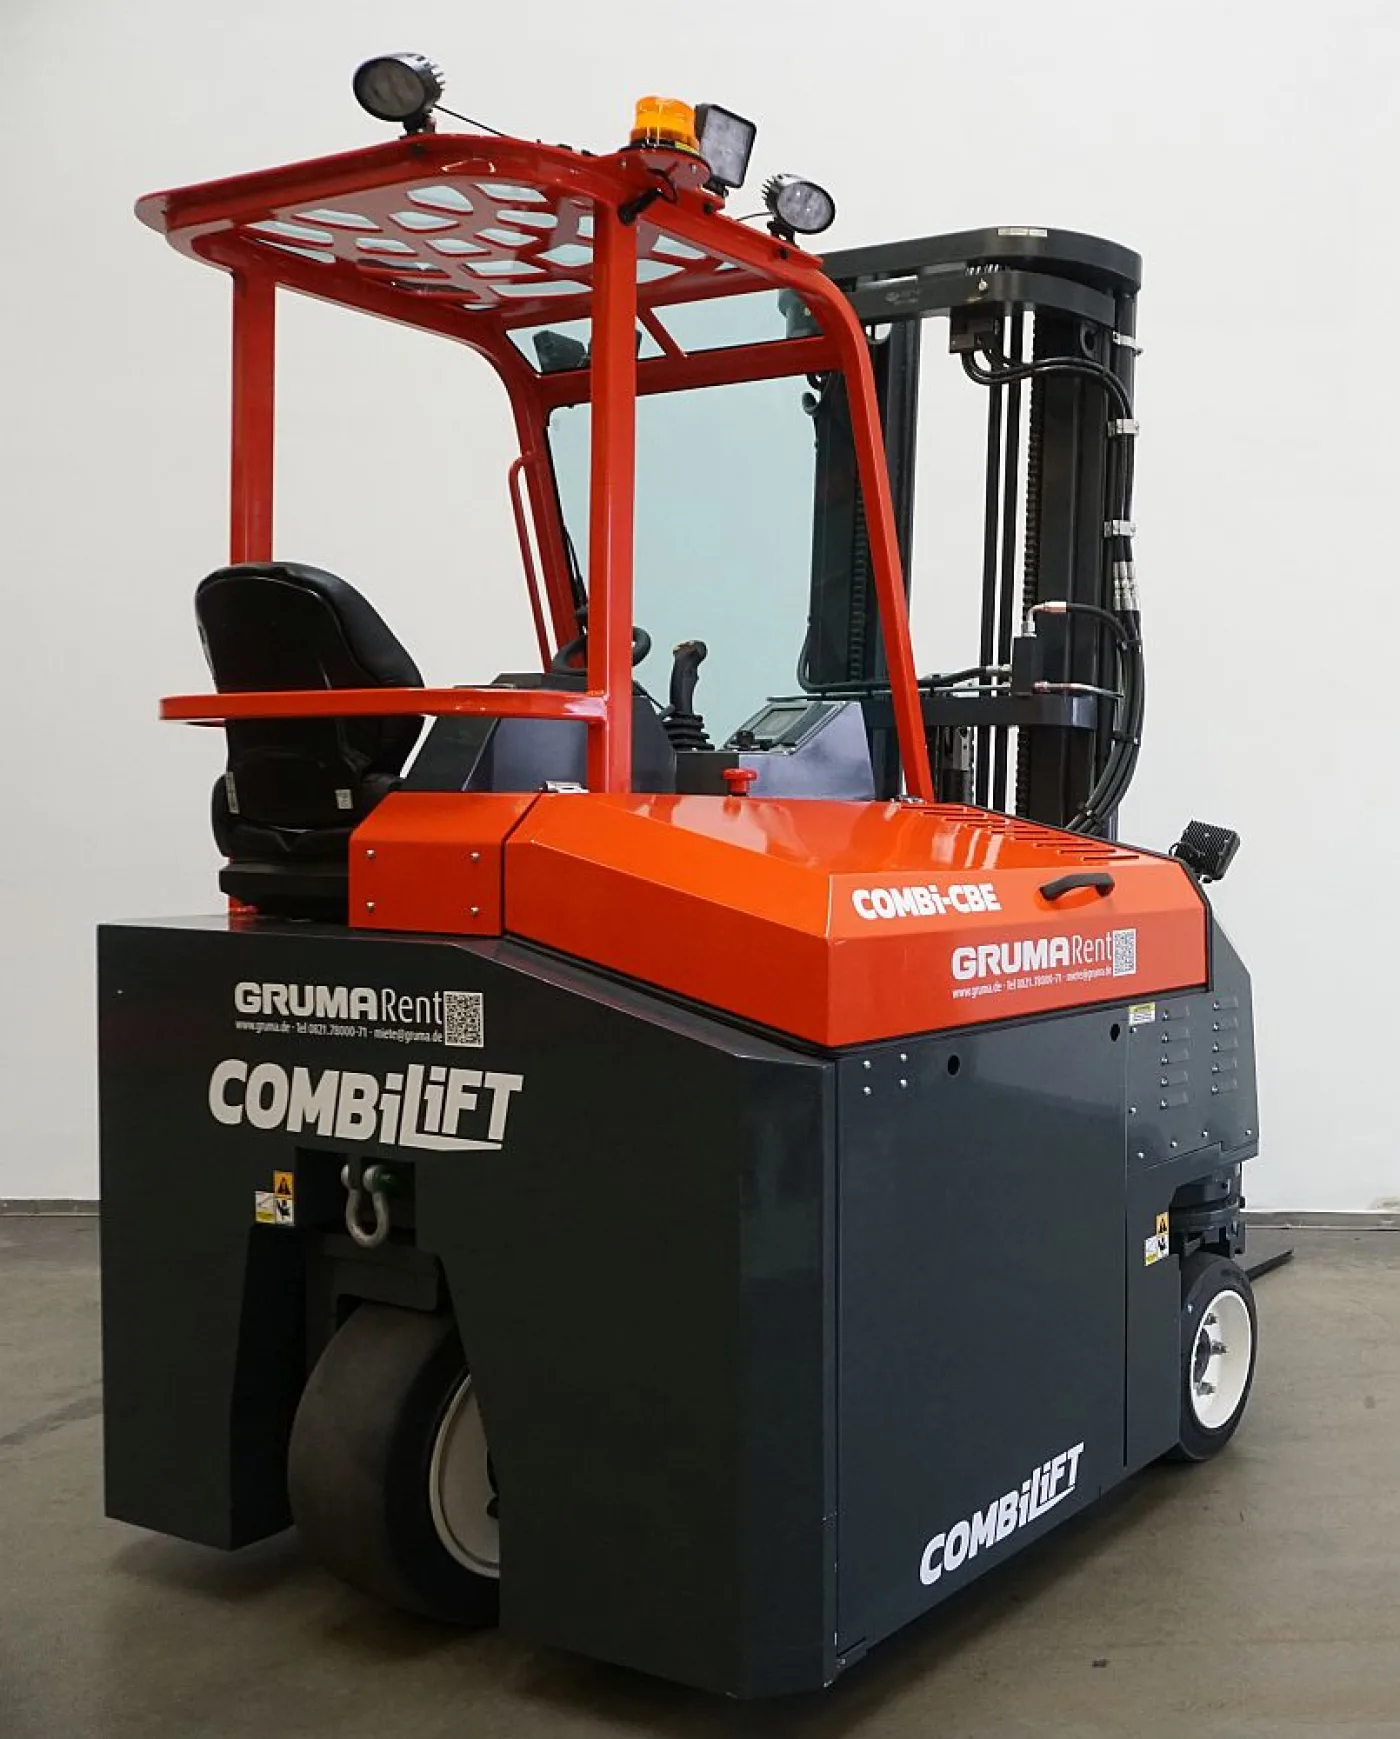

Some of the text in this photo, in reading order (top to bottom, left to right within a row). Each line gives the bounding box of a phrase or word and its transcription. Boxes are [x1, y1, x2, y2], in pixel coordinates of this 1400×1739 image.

[852, 883, 1002, 920] COMBi-CBE
[952, 932, 1112, 980] GRUMA Rent
[234, 981, 442, 1025] GRUMA Rent
